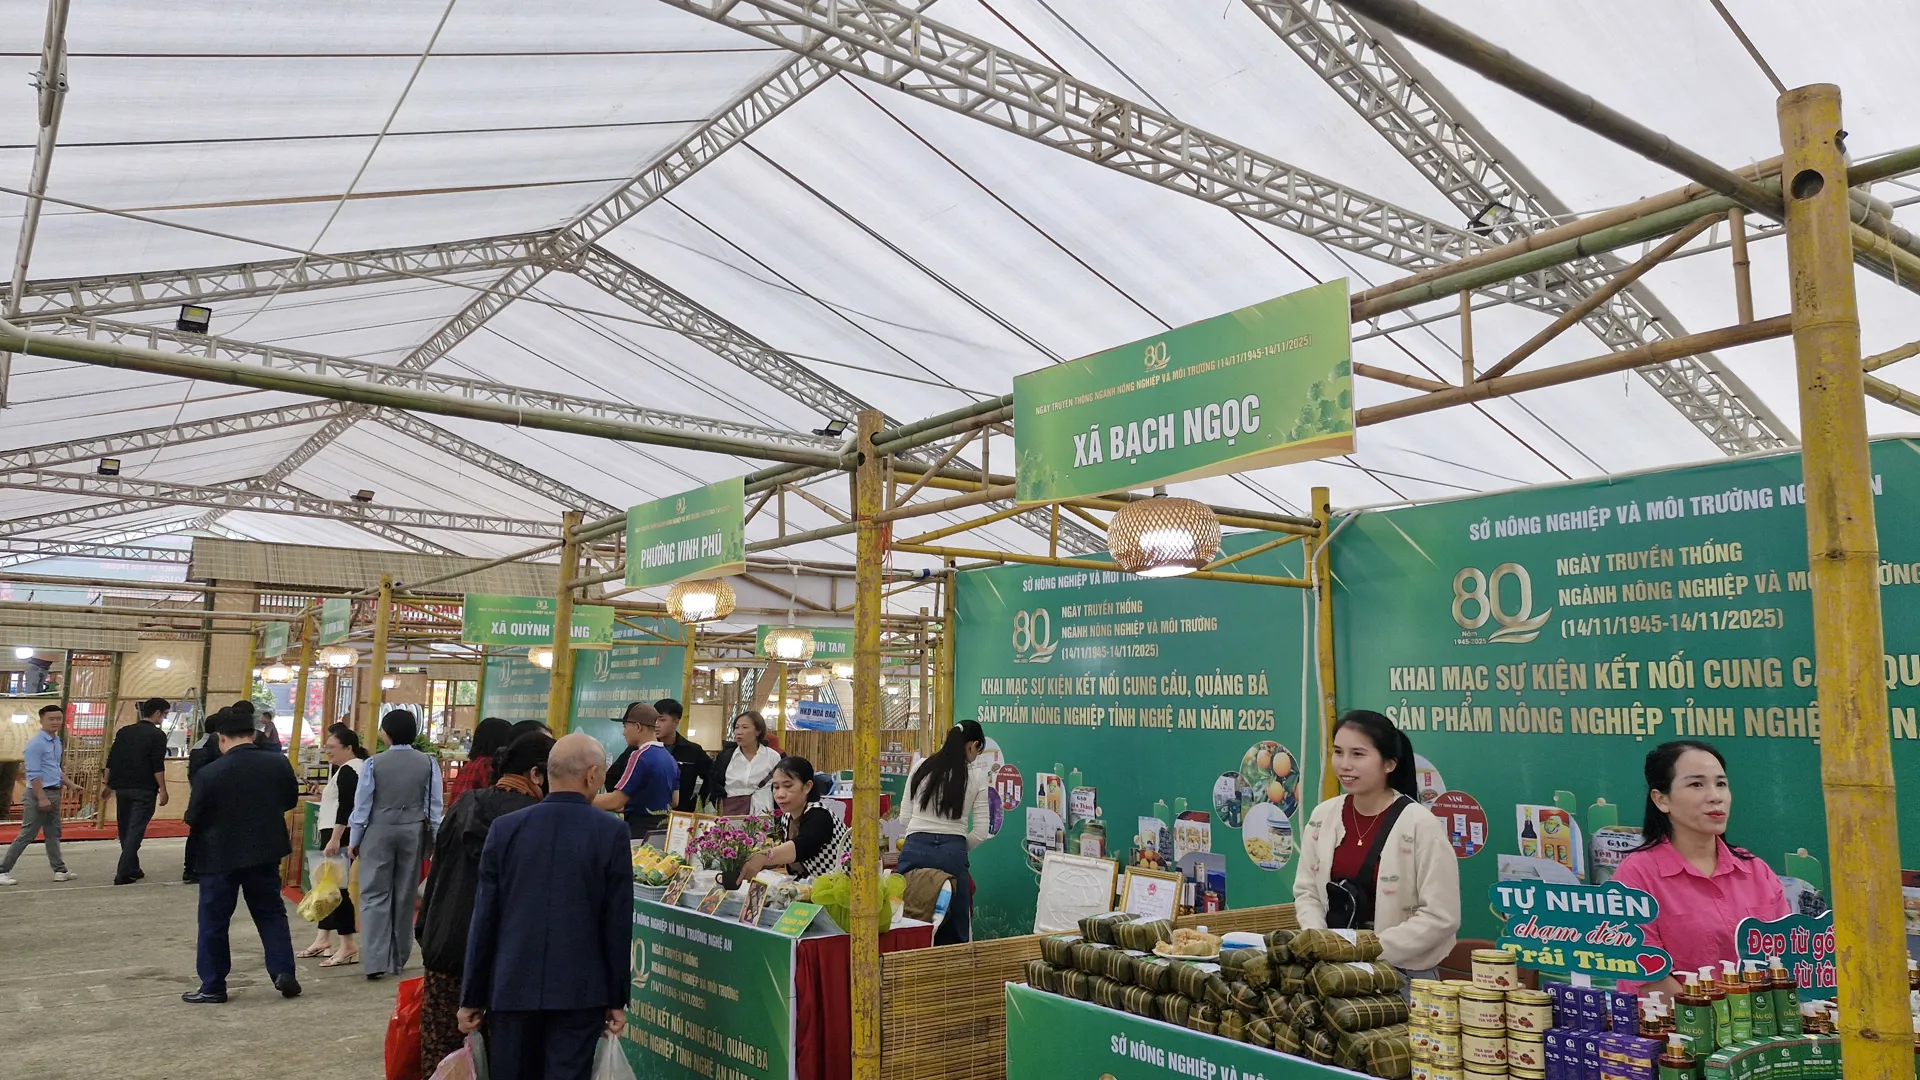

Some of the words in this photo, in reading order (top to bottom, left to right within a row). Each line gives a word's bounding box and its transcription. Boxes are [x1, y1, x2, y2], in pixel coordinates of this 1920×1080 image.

[1073, 422, 1104, 468] XÃ
[1109, 413, 1175, 465] BẠCH
[1182, 393, 1261, 448] NGỌC
[1469, 515, 1491, 541] SỞ
[1494, 512, 1542, 538] NÔNG
[1546, 505, 1612, 532] NGHIỆP
[1615, 499, 1642, 524] VÀ
[1646, 495, 1685, 522] MÔI
[1689, 486, 1774, 517] TRƯỜNG
[640, 540, 675, 569] PHƯỜNG
[677, 537, 699, 562] VINH
[701, 528, 722, 558] PHÚ
[1556, 553, 1601, 577] NGÀY
[1606, 542, 1674, 572] TRUYỀN
[1678, 537, 1743, 566] THỐNG
[1022, 576, 1033, 592] SỞ
[1034, 576, 1056, 591] NÔNG
[1058, 571, 1088, 590] NGHIỆP
[1089, 569, 1101, 585] VÀ
[1451, 562, 1534, 631] 80
[1558, 582, 1617, 607] NGÀNH
[1622, 579, 1673, 603] NÔNG
[1678, 572, 1749, 600] NGHIỆP
[1754, 568, 1782, 594] VÀ
[1061, 603, 1082, 618] NGÀY
[1083, 598, 1114, 617] TRUYỀN
[1115, 596, 1143, 614] THỐNG
[1561, 607, 1784, 639] (14/11/1945-14/11/2025)
[491, 620, 507, 635] XÃ
[510, 621, 550, 637] QUỲNH
[1061, 623, 1088, 639] NGÀNH
[1089, 622, 1112, 637] NÔNG
[1113, 619, 1145, 638] NGHIỆP
[1146, 618, 1159, 635] VÀ
[1160, 617, 1179, 634] MÔI
[1180, 615, 1218, 632] TRƯỜNG
[1061, 643, 1159, 660] (14/11/1945-14/11/2025)
[980, 676, 1003, 696] KHAI
[1005, 676, 1028, 698] MẠC
[1030, 675, 1046, 699] SỰ
[1047, 673, 1073, 699] KIỆN
[1075, 670, 1096, 696] KẾT
[1099, 669, 1120, 696] NỐI
[1122, 675, 1157, 696] CUNG
[1160, 668, 1192, 699] CẦU,
[1195, 667, 1244, 698] QUẢNG
[1247, 669, 1269, 696] BÁ
[1389, 665, 1436, 692] KHAI
[1441, 664, 1490, 696] MẠC
[1495, 661, 1527, 696] SỰ
[1532, 657, 1588, 696] KIỆN
[1594, 652, 1641, 690] KẾT
[1648, 649, 1695, 689] NỐI
[1703, 657, 1784, 689] CUNG
[977, 700, 998, 723] SẢN
[999, 698, 1029, 724] PHẨM
[1031, 702, 1061, 725] NÔNG
[1063, 704, 1106, 730] NGHIỆP
[1108, 701, 1137, 728] TỈNH
[1139, 704, 1174, 733] NGHỆ
[1177, 709, 1197, 729] AN
[1200, 704, 1235, 731] NĂM
[1238, 709, 1275, 732] 2025
[1385, 698, 1426, 731] SẢN
[1431, 696, 1493, 732] PHẨM
[1499, 701, 1564, 734] NÔNG
[1570, 701, 1664, 742] NGHIỆP
[1671, 697, 1736, 737] TỈNH
[1743, 701, 1821, 745] NGHỆ
[1496, 886, 1536, 915] TỰ
[1545, 888, 1651, 918] NHIÊN
[650, 916, 667, 934] NGHIỆP
[687, 928, 708, 945] TRƯỜNG
[708, 933, 723, 951] NGHỆ
[723, 938, 733, 952] AN
[1513, 914, 1581, 945] chạm
[1585, 919, 1637, 948] đến
[1747, 928, 1787, 961] Đẹp
[1789, 924, 1810, 954] từ
[1501, 942, 1566, 967] Trái
[1572, 948, 1638, 975] Tim
[1793, 959, 1814, 989] từ
[640, 1001, 656, 1026] KIỆN
[657, 1006, 670, 1030] KẾT
[671, 1012, 684, 1036] NỐI
[685, 1020, 706, 1046] CUNG
[726, 1035, 755, 1065] QUẢNG
[756, 1047, 769, 1071] BÁ
[649, 1032, 675, 1062] NGHIỆP
[675, 1040, 692, 1069] TỈNH
[1110, 1031, 1127, 1055] SỞ
[1129, 1040, 1165, 1068] NÔNG
[1168, 1052, 1217, 1080] NGHIỆP
